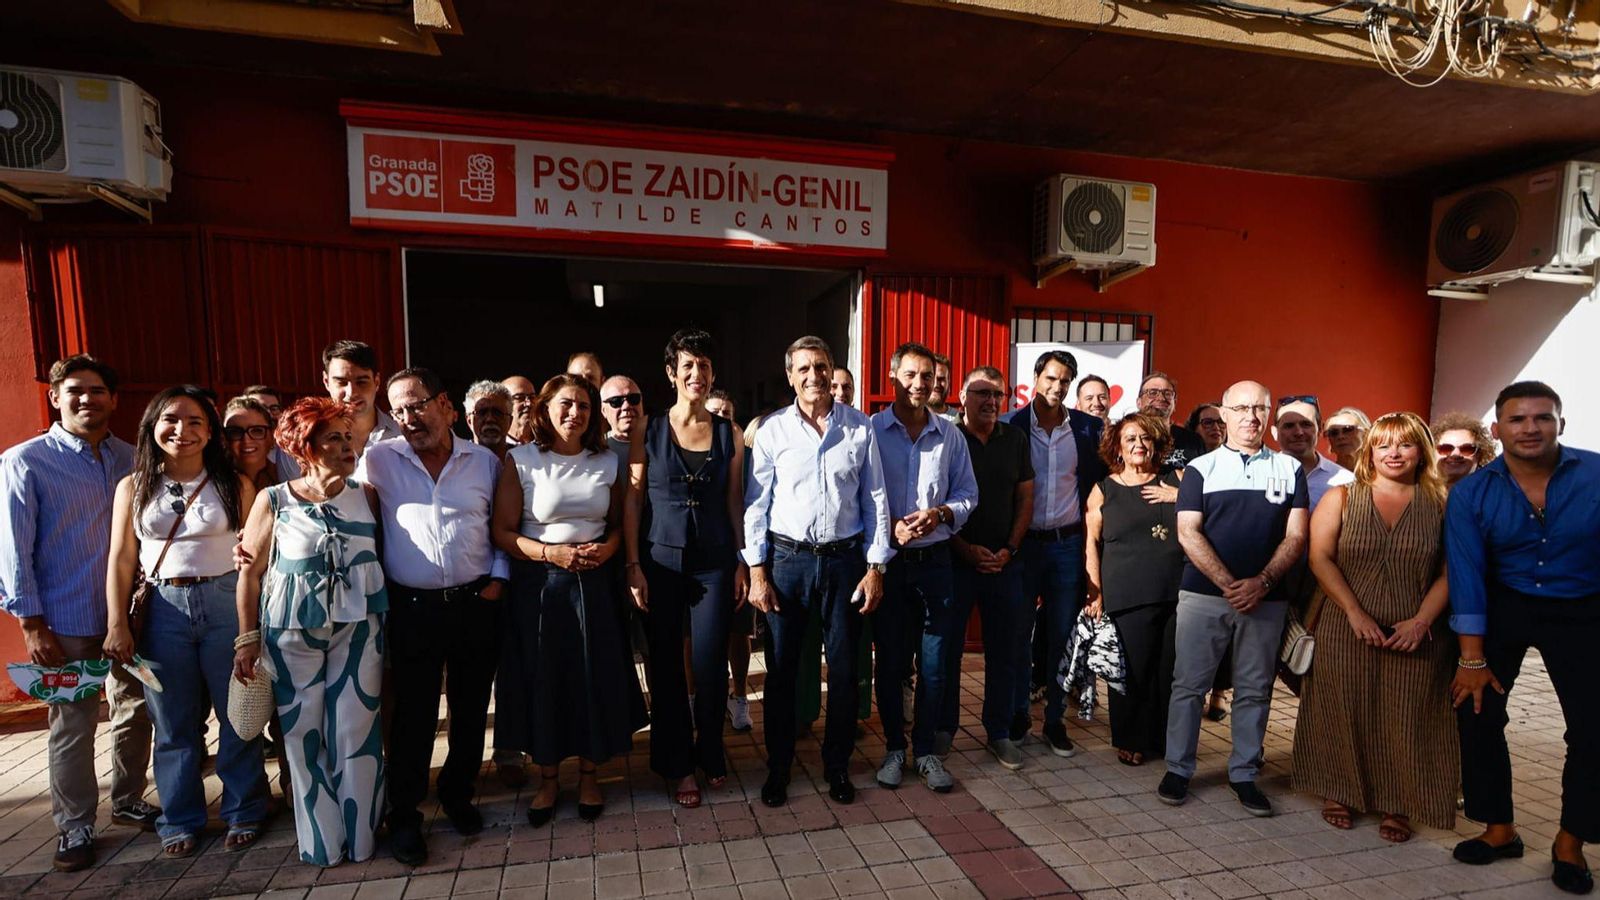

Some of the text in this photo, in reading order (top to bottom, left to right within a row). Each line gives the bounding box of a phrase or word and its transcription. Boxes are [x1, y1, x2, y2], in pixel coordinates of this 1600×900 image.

[369, 154, 437, 172] Granada
[369, 171, 438, 198] PSOE
[533, 155, 871, 212] PSOE ZAIDÍN-GENIL
[535, 198, 871, 236] MATILDE CANTOS
[1265, 477, 1287, 505] U
